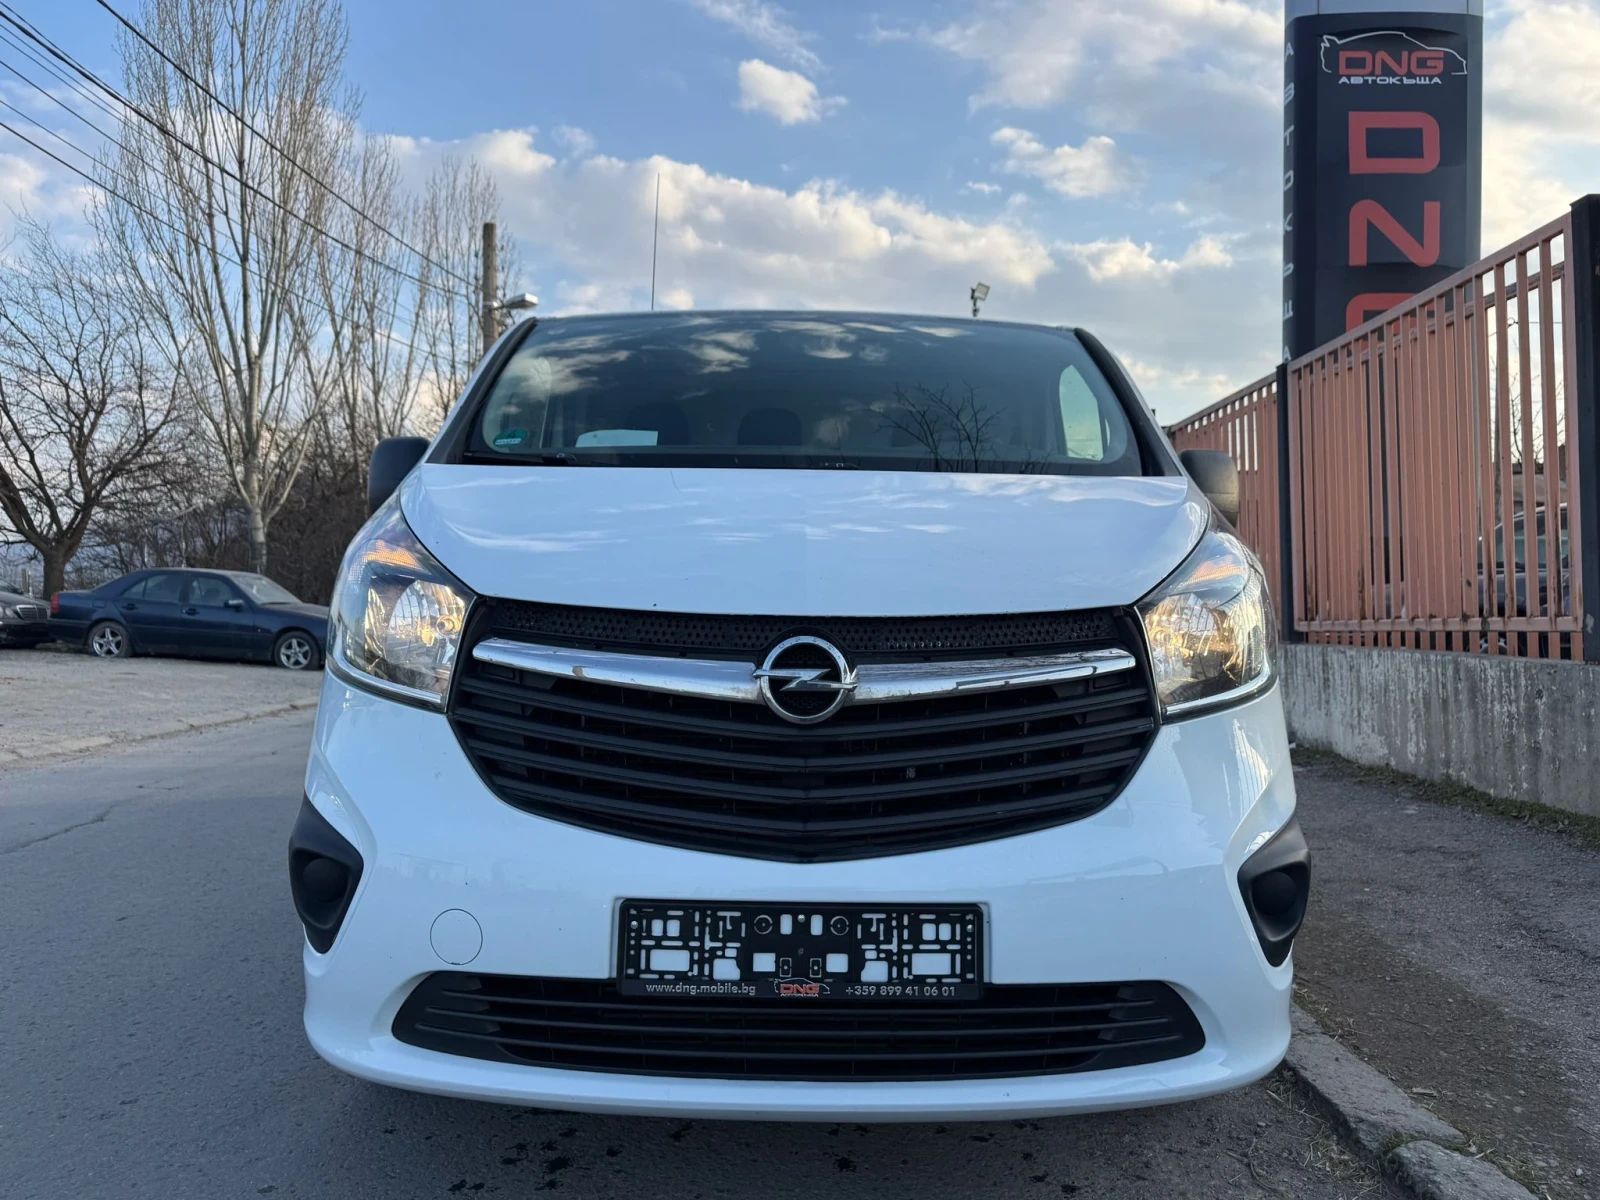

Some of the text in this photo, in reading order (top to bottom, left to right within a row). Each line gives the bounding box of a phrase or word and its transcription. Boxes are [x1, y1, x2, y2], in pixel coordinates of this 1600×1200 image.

[1338, 50, 1444, 75] DNG
[1338, 76, 1442, 84] АВТОКЪША
[645, 982, 756, 996] www.dng.mobile.bg
[780, 983, 820, 994] DNG
[845, 985, 955, 996] +359 899 41 06 01
